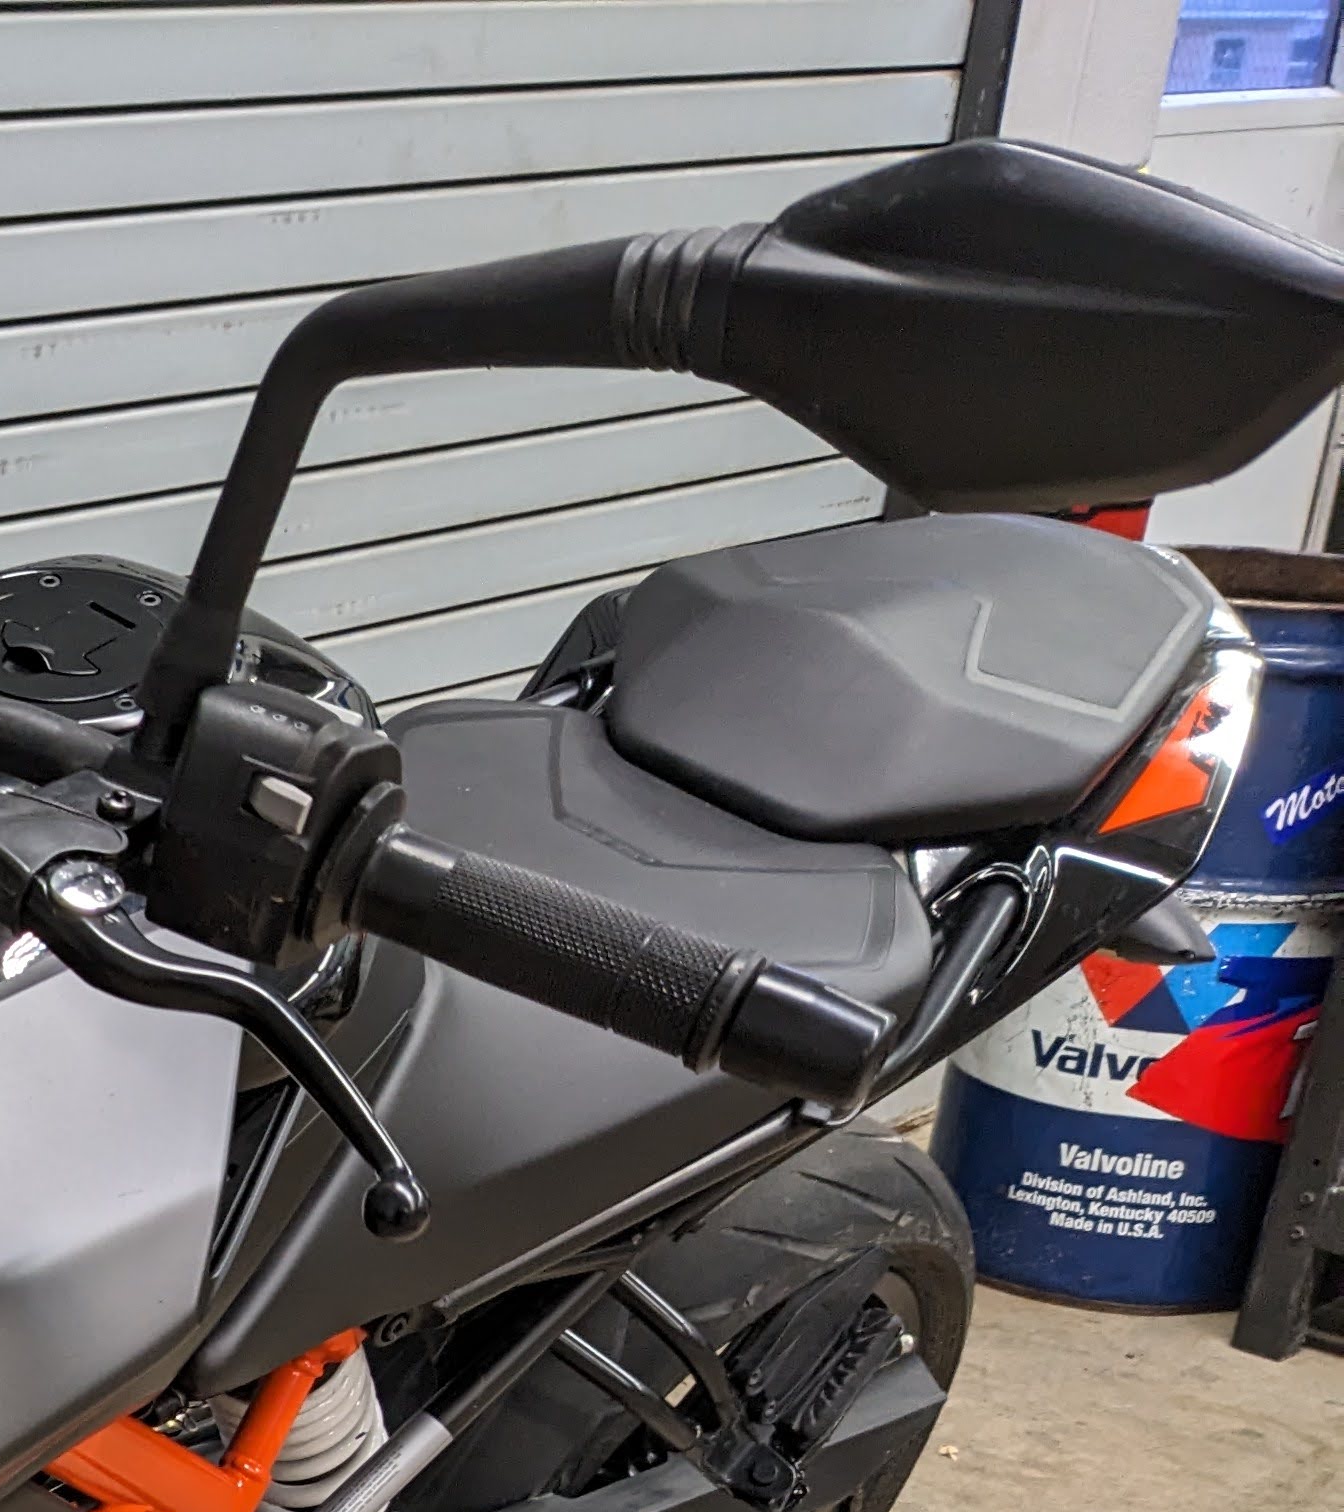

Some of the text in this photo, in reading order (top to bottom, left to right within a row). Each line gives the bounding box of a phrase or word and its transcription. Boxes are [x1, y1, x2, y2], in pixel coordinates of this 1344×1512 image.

[1060, 1142, 1185, 1180] Valvoline
[1008, 1185, 1216, 1225] Lexington, Kentucky 40509
[1021, 1171, 1208, 1208] Division of Ashland, Inc.
[1049, 1212, 1165, 1240] Made in U.S.A.
